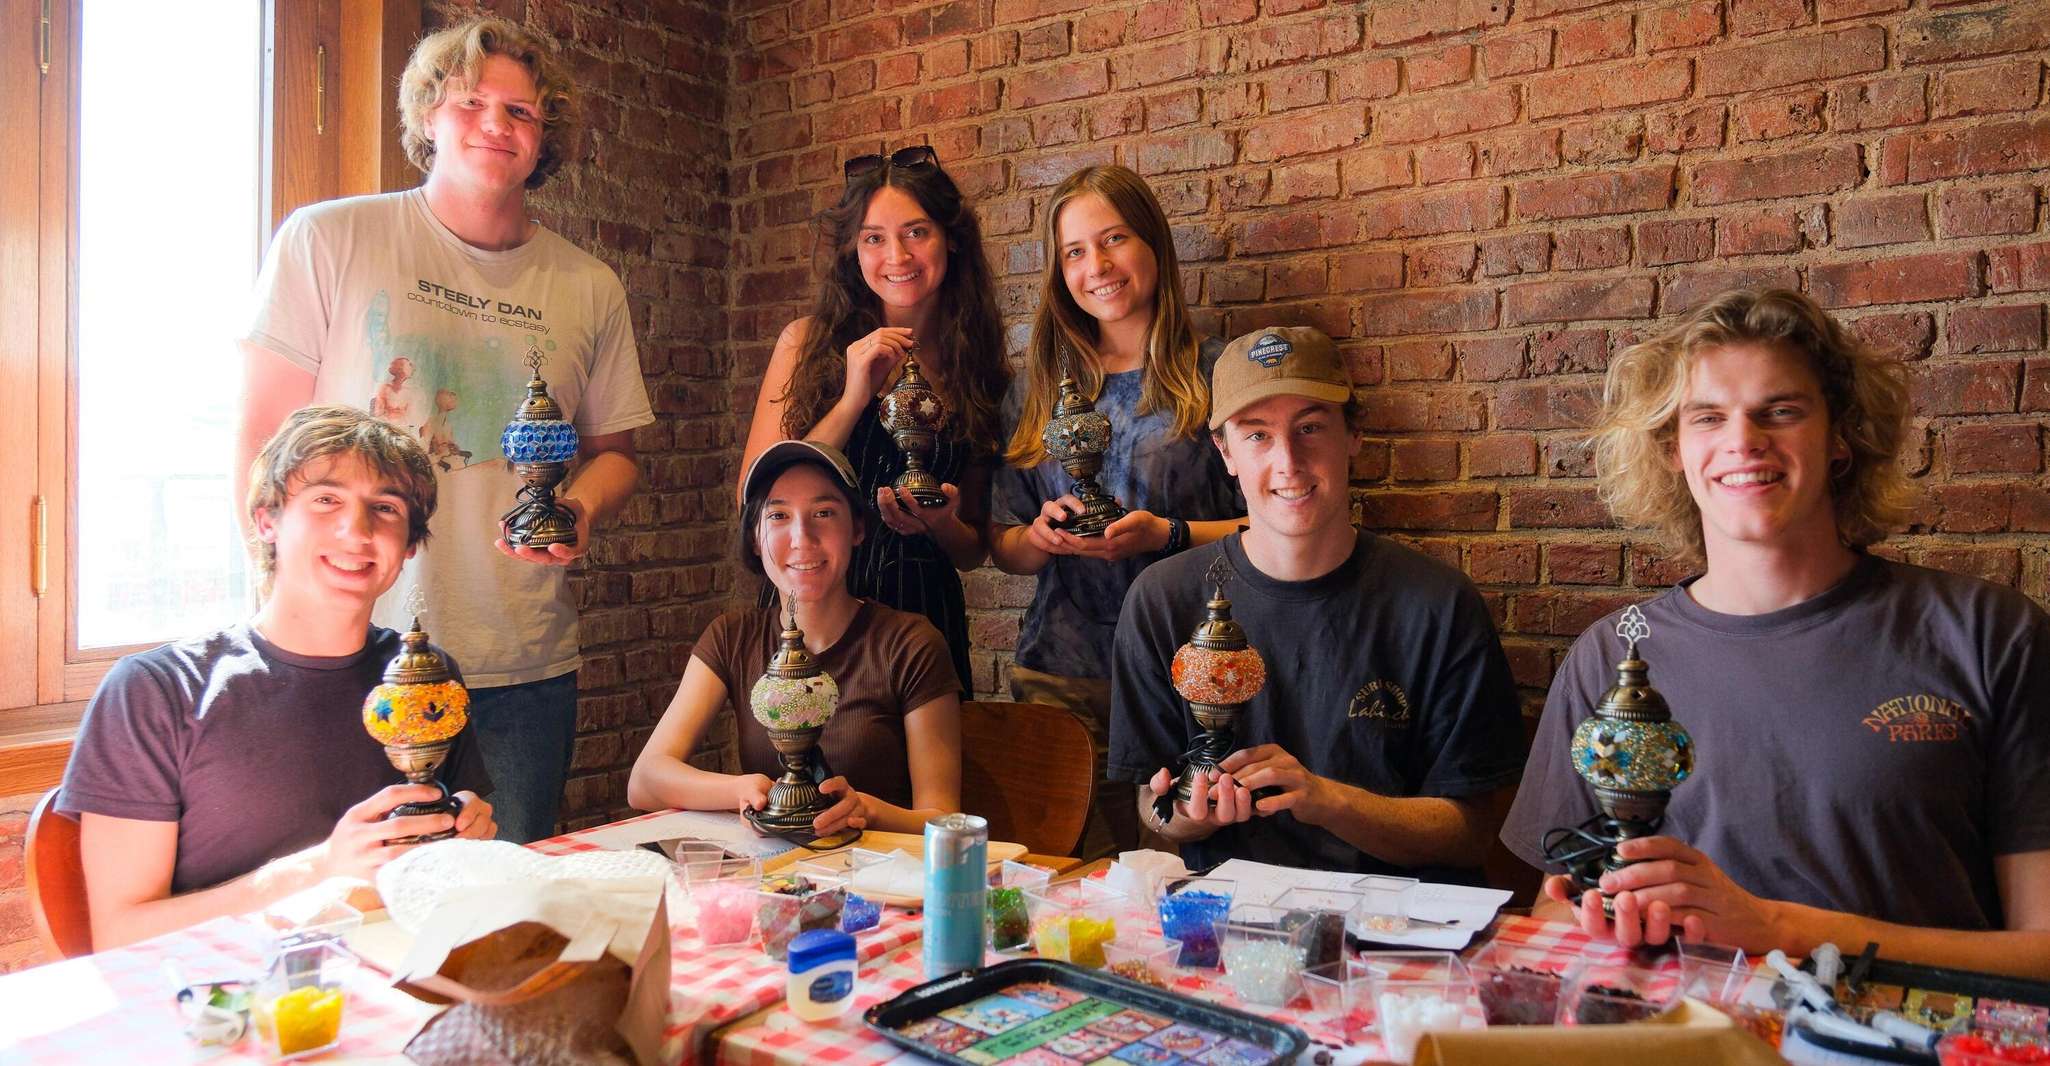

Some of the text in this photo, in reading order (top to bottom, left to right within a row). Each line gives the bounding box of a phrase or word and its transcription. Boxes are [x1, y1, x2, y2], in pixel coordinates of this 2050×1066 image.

[407, 291, 551, 335] countdown to ecstasy
[418, 279, 542, 321] STEELY DAN
[1861, 694, 1972, 733] NATION
[1888, 723, 1958, 742] PARKS
